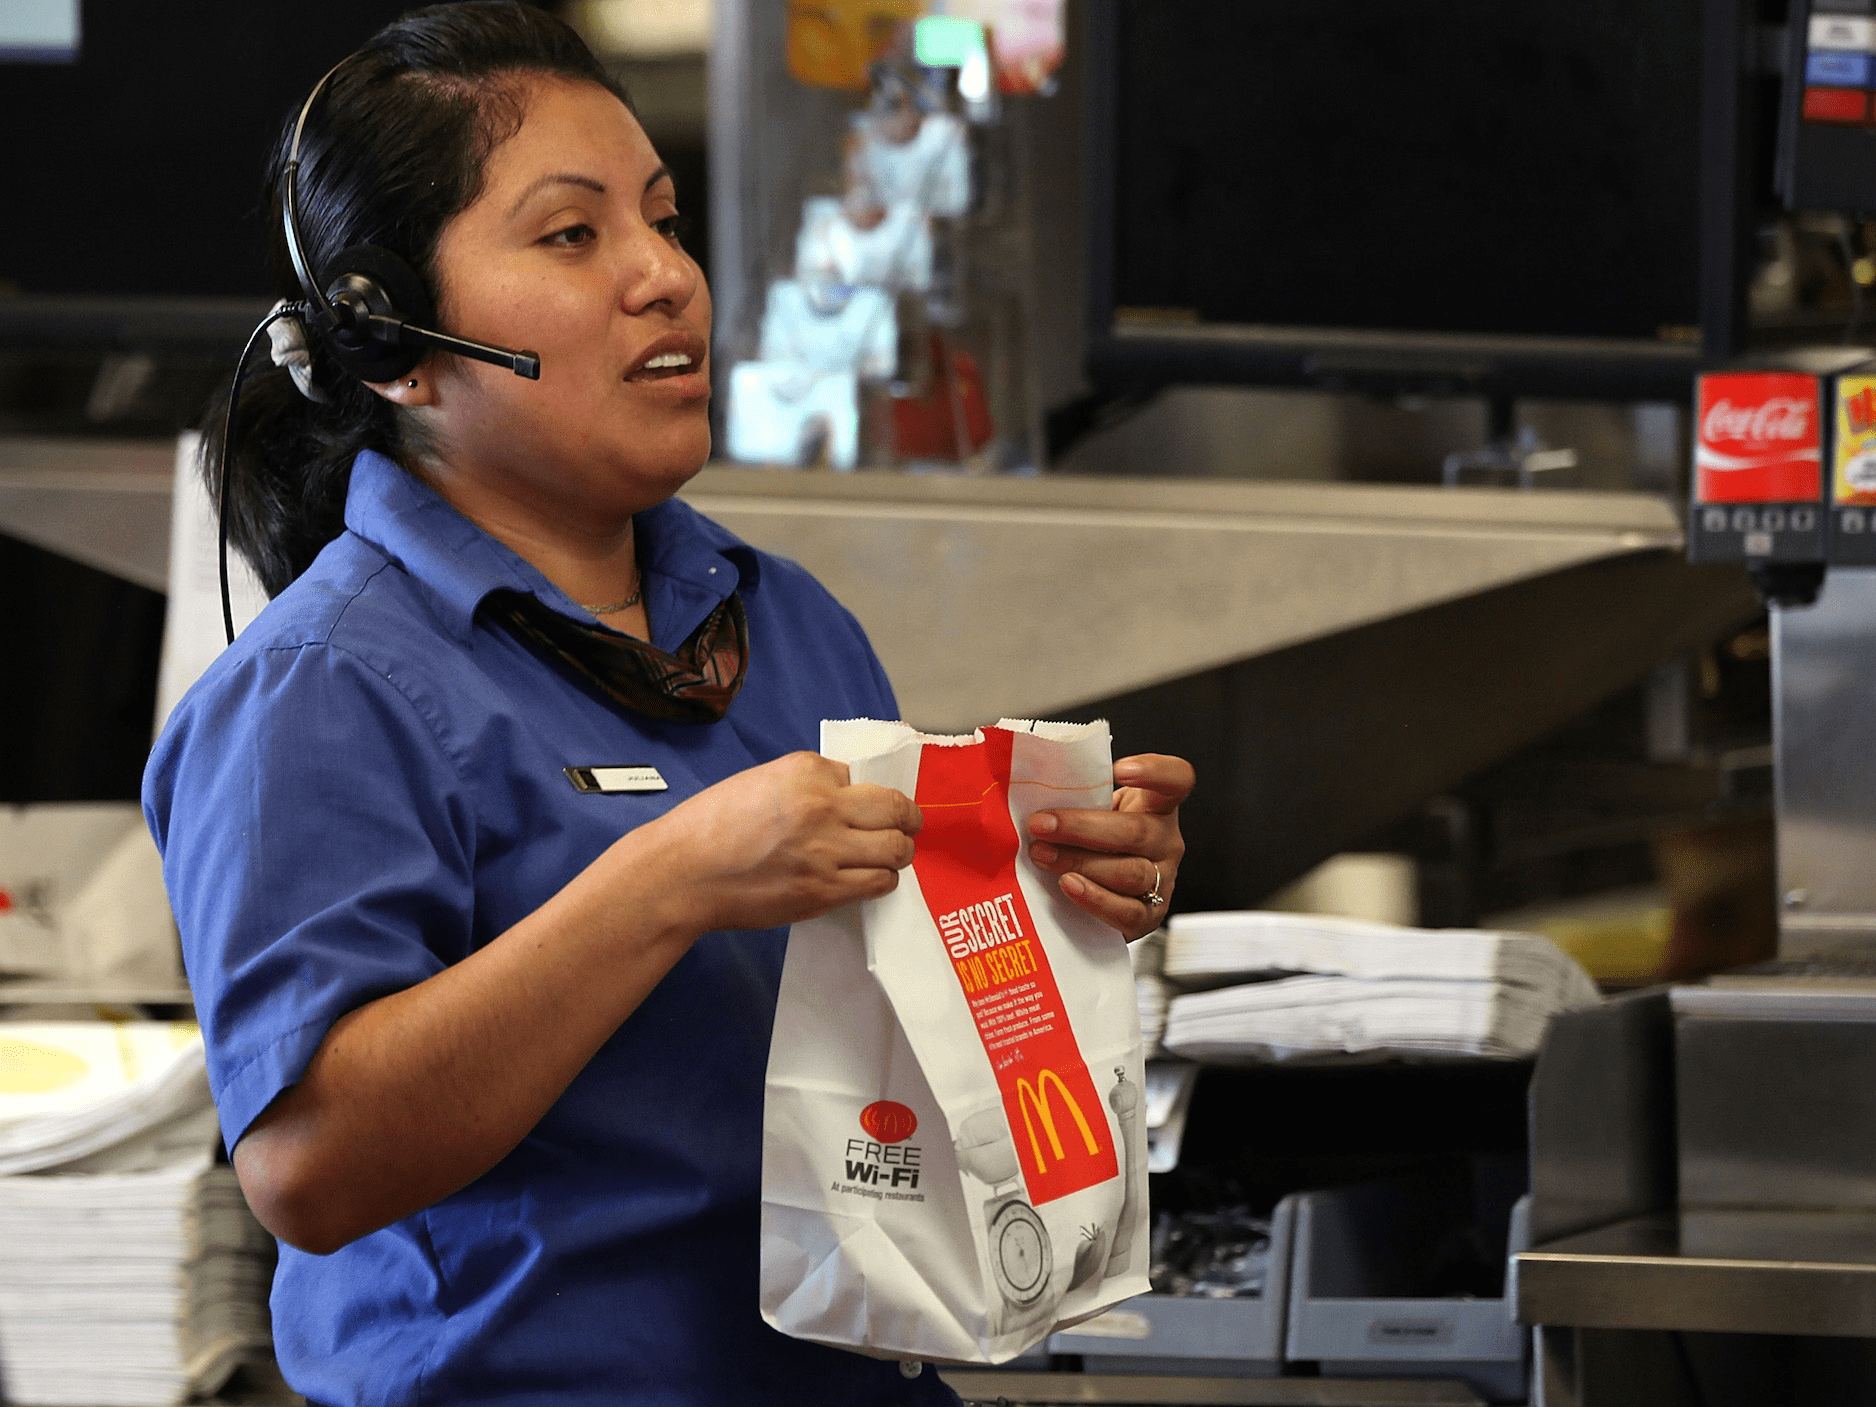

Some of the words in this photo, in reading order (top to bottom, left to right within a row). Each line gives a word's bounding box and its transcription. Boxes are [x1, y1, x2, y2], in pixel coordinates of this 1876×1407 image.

[938, 911, 970, 959] OUR
[959, 893, 1024, 953] SECRET
[956, 961, 974, 994] IS
[967, 956, 989, 991] NO
[985, 939, 1038, 986] SECRET
[846, 1139, 921, 1166] FREE
[831, 1181, 840, 1192] At
[841, 1184, 883, 1200] participating
[885, 1191, 925, 1203] restaurants
[846, 1160, 919, 1189] Wi-Fi
